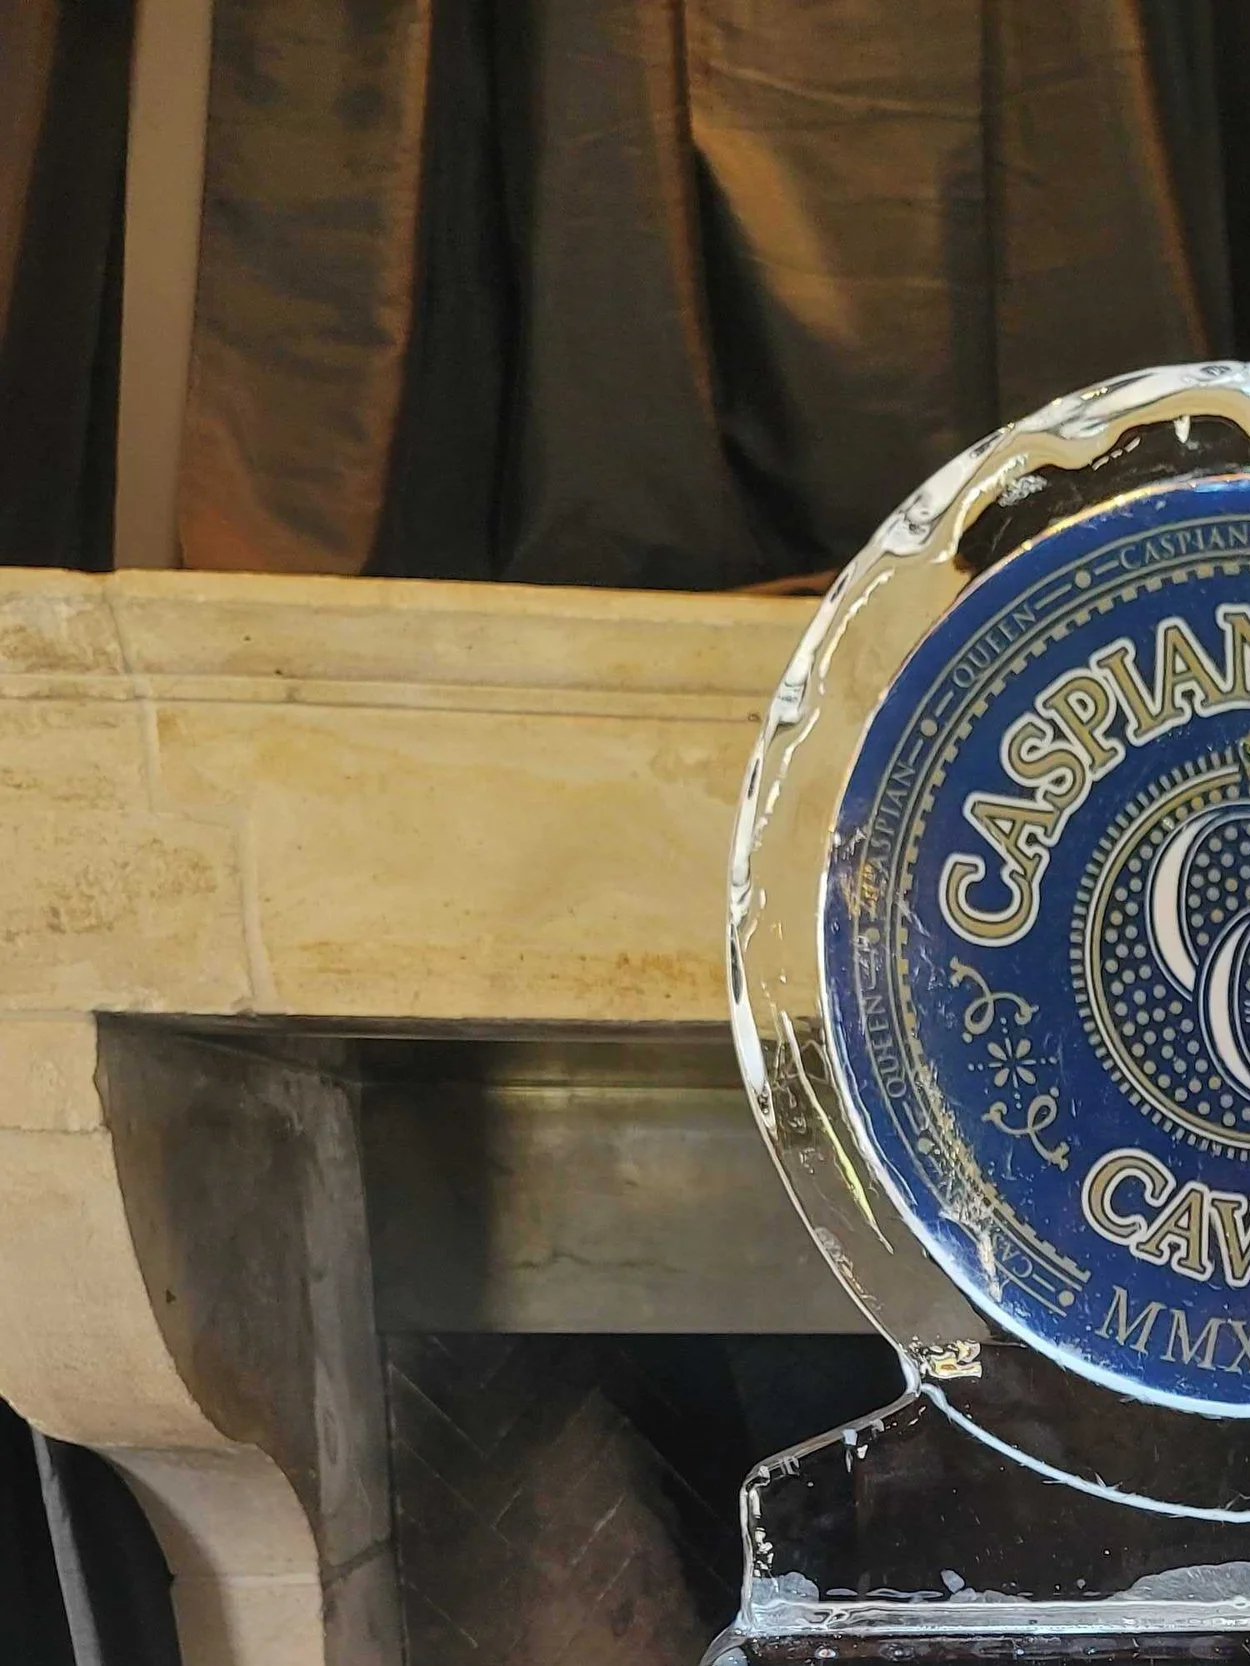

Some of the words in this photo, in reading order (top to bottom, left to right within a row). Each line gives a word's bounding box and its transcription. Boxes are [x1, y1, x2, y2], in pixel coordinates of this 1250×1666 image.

[1119, 523, 1250, 570] CASPIAN
[952, 603, 1037, 690] QUEEN
[864, 993, 908, 1099] QUEEN
